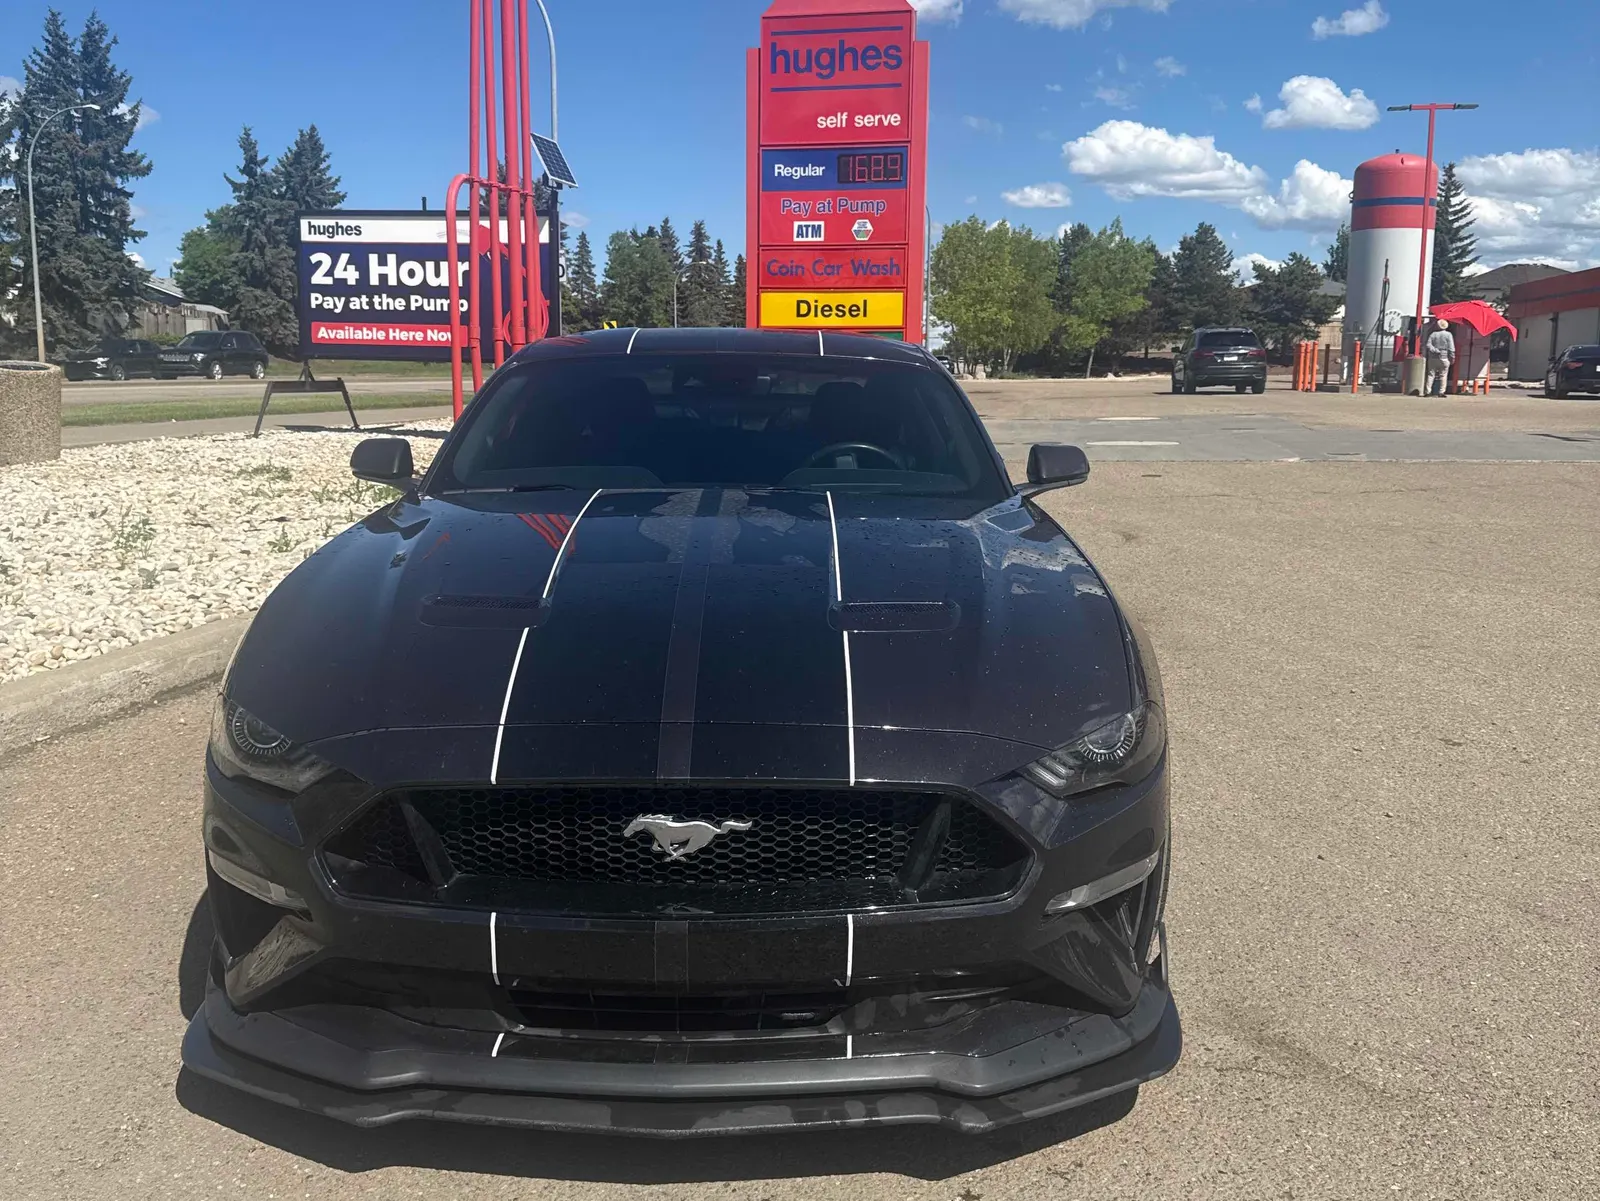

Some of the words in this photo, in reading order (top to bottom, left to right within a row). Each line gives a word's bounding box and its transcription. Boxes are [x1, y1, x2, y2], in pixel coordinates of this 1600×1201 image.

[770, 40, 903, 80] hughes
[817, 112, 848, 128] self
[854, 112, 901, 127] serve
[774, 163, 825, 180] Regular
[781, 198, 812, 216] Pay
[816, 199, 833, 214] at
[837, 197, 887, 216] Pump
[307, 221, 362, 239] hughes
[796, 224, 822, 239] ATM
[309, 252, 360, 285] 24
[368, 252, 470, 287] Hour
[767, 259, 805, 276] Coin
[812, 259, 843, 276] Car
[851, 257, 900, 276] Wash
[310, 293, 344, 313] Pay
[349, 295, 370, 310] at
[372, 294, 406, 311] the
[795, 299, 868, 318] Diesel
[317, 326, 386, 342] Available
[388, 328, 424, 342] Here
[426, 329, 452, 342] No
